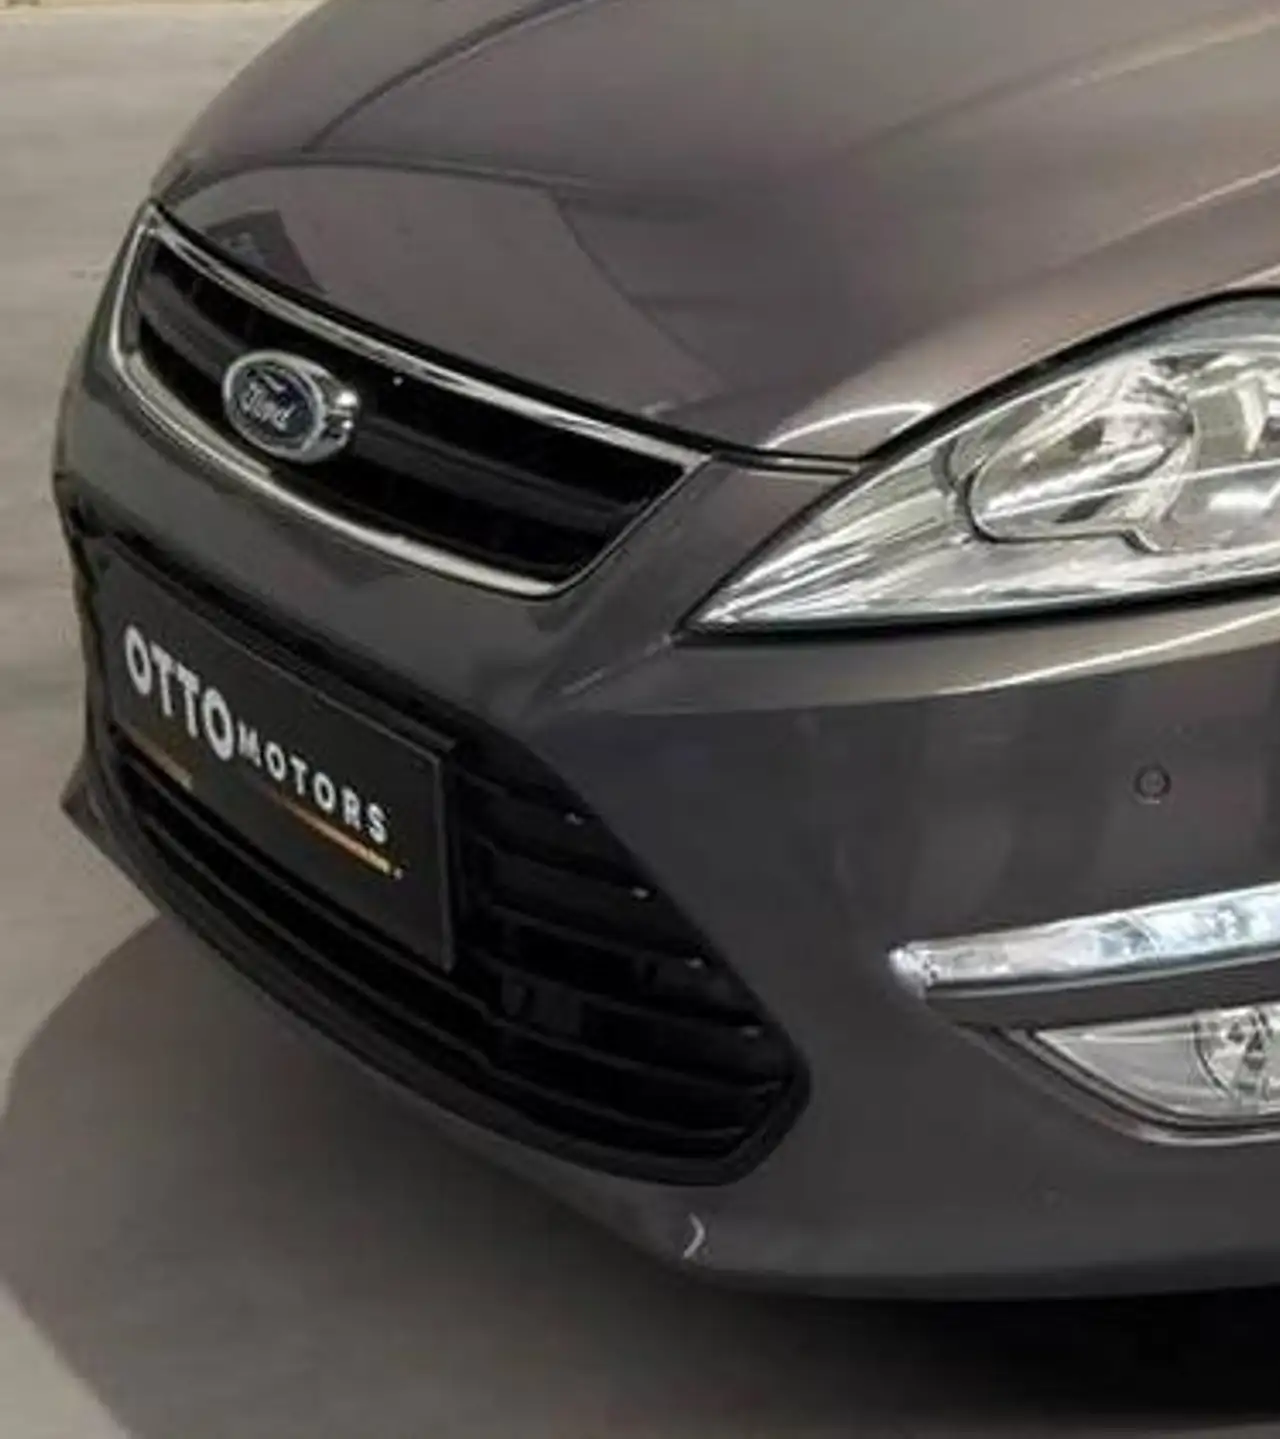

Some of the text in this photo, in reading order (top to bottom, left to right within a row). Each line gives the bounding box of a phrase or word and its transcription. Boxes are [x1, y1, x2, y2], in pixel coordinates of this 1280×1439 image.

[240, 373, 298, 433] Ford
[124, 624, 388, 844] OTTO MOTORS
